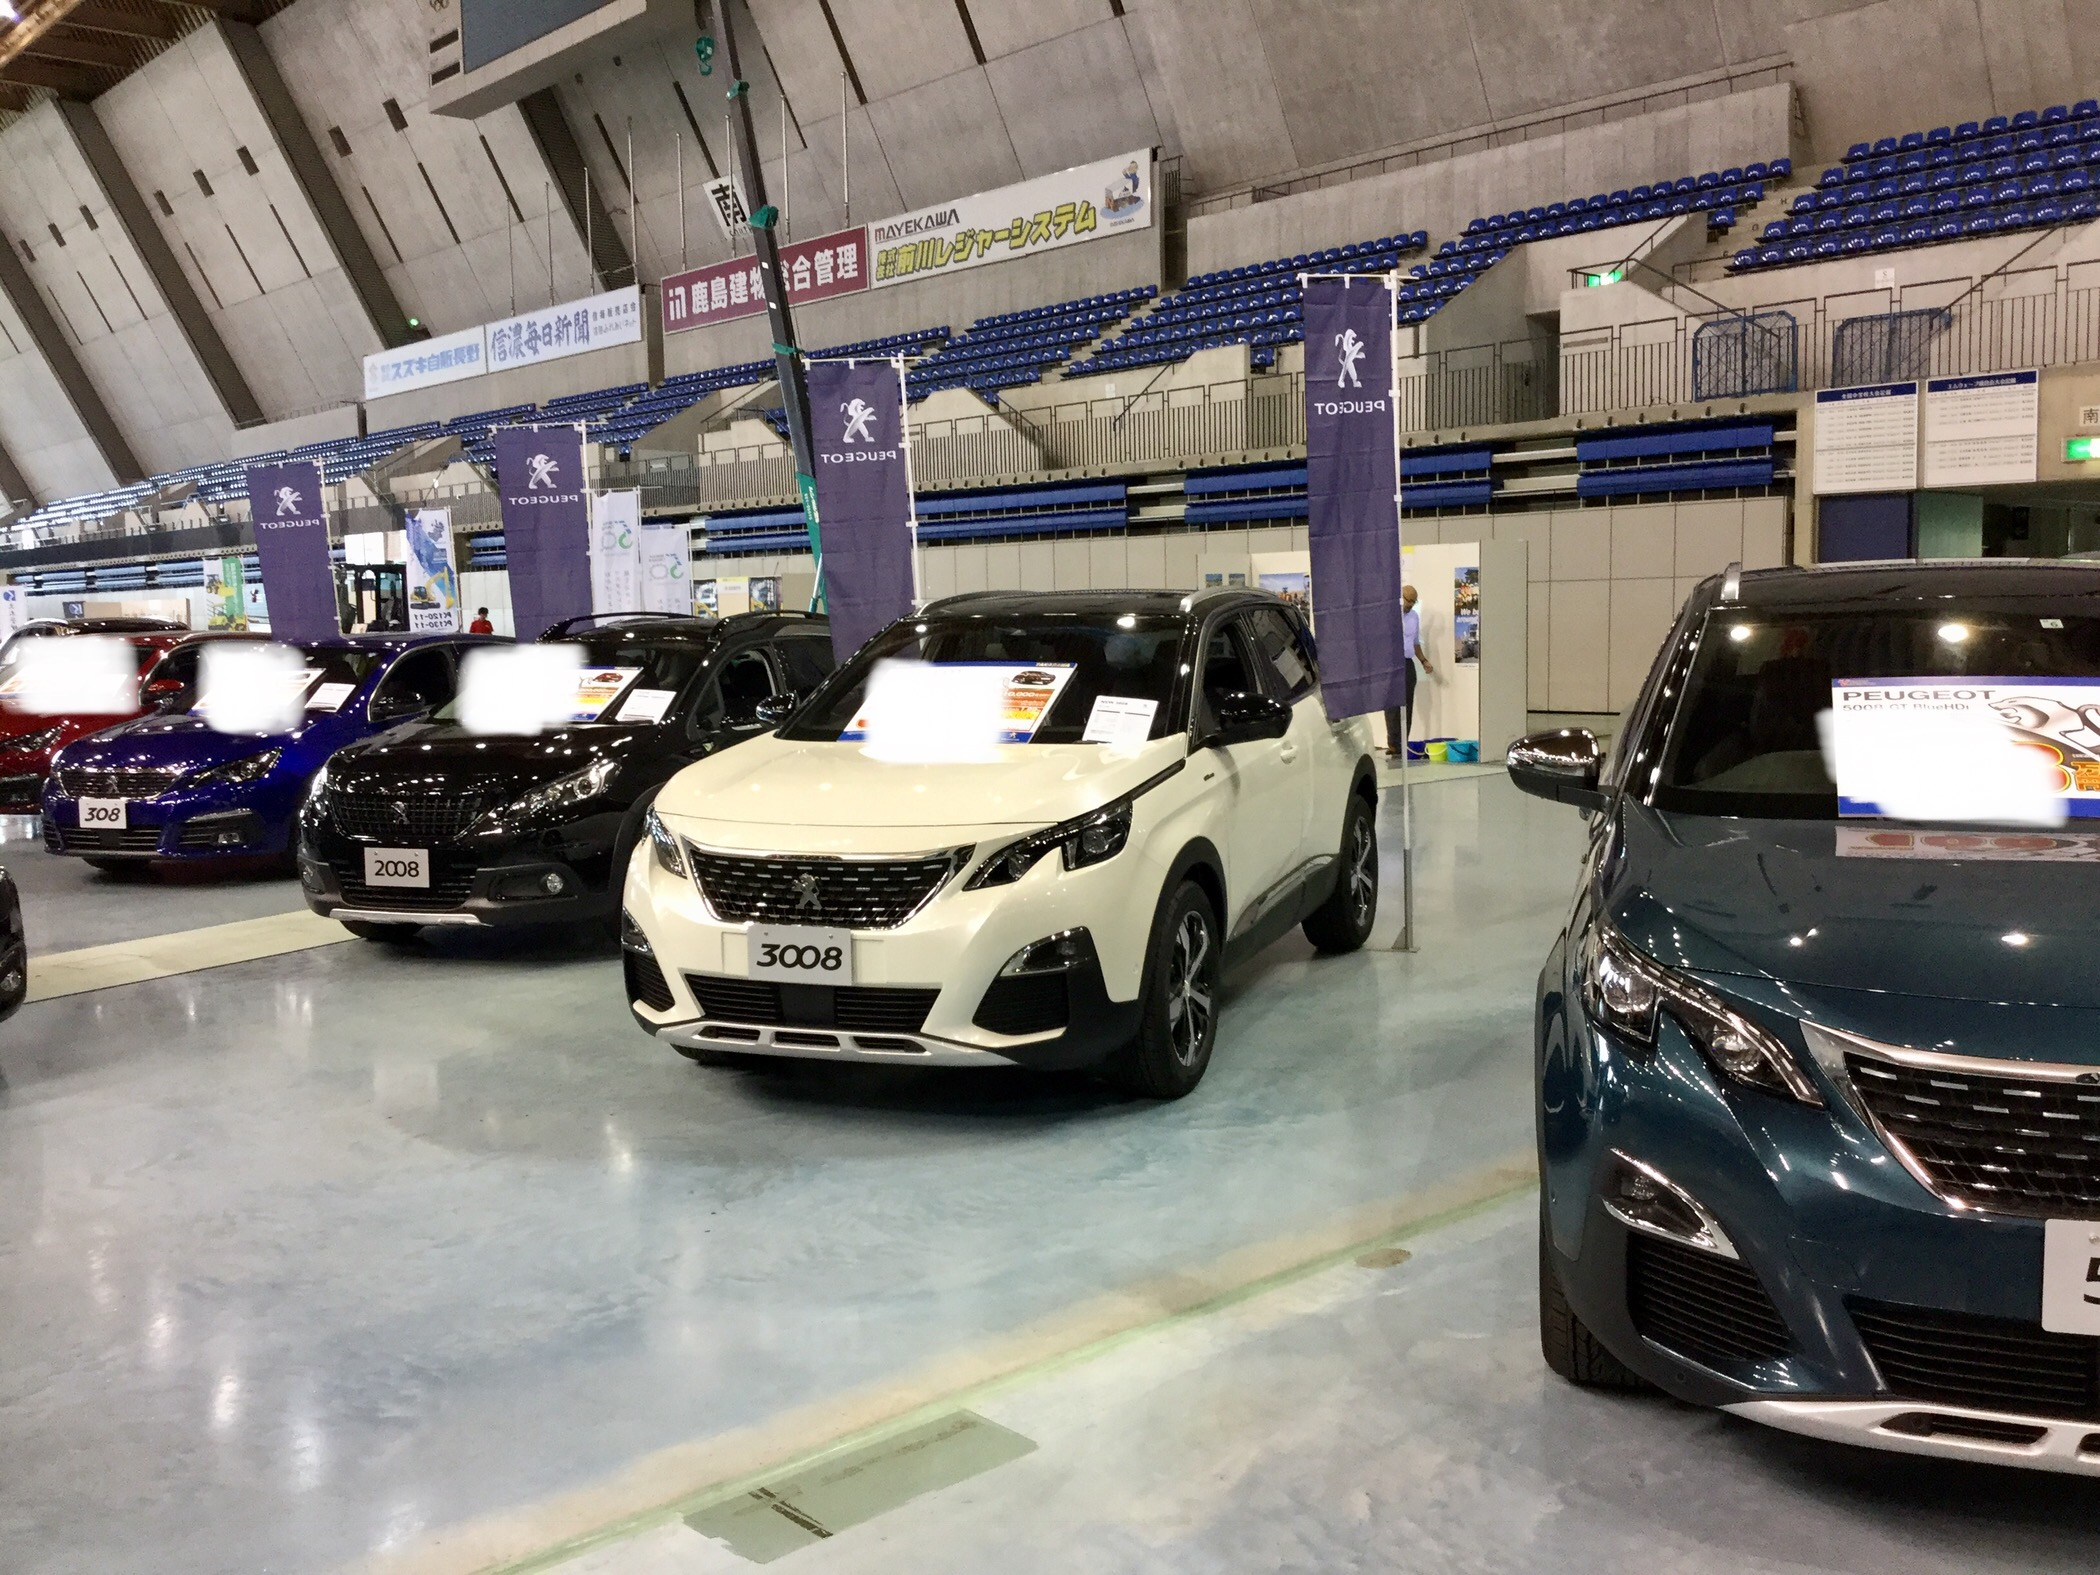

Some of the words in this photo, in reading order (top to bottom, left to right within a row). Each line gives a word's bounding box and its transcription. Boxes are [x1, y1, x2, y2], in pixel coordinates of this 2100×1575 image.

[875, 208, 960, 241] MAYEKAWA
[897, 200, 1097, 276] 前川レジャーシステム
[491, 308, 590, 362] 信濃毎日新聞
[1843, 690, 1996, 702] PEUGEOT
[84, 807, 121, 822] 308
[374, 860, 420, 878] 2008
[756, 943, 843, 971] 3008
